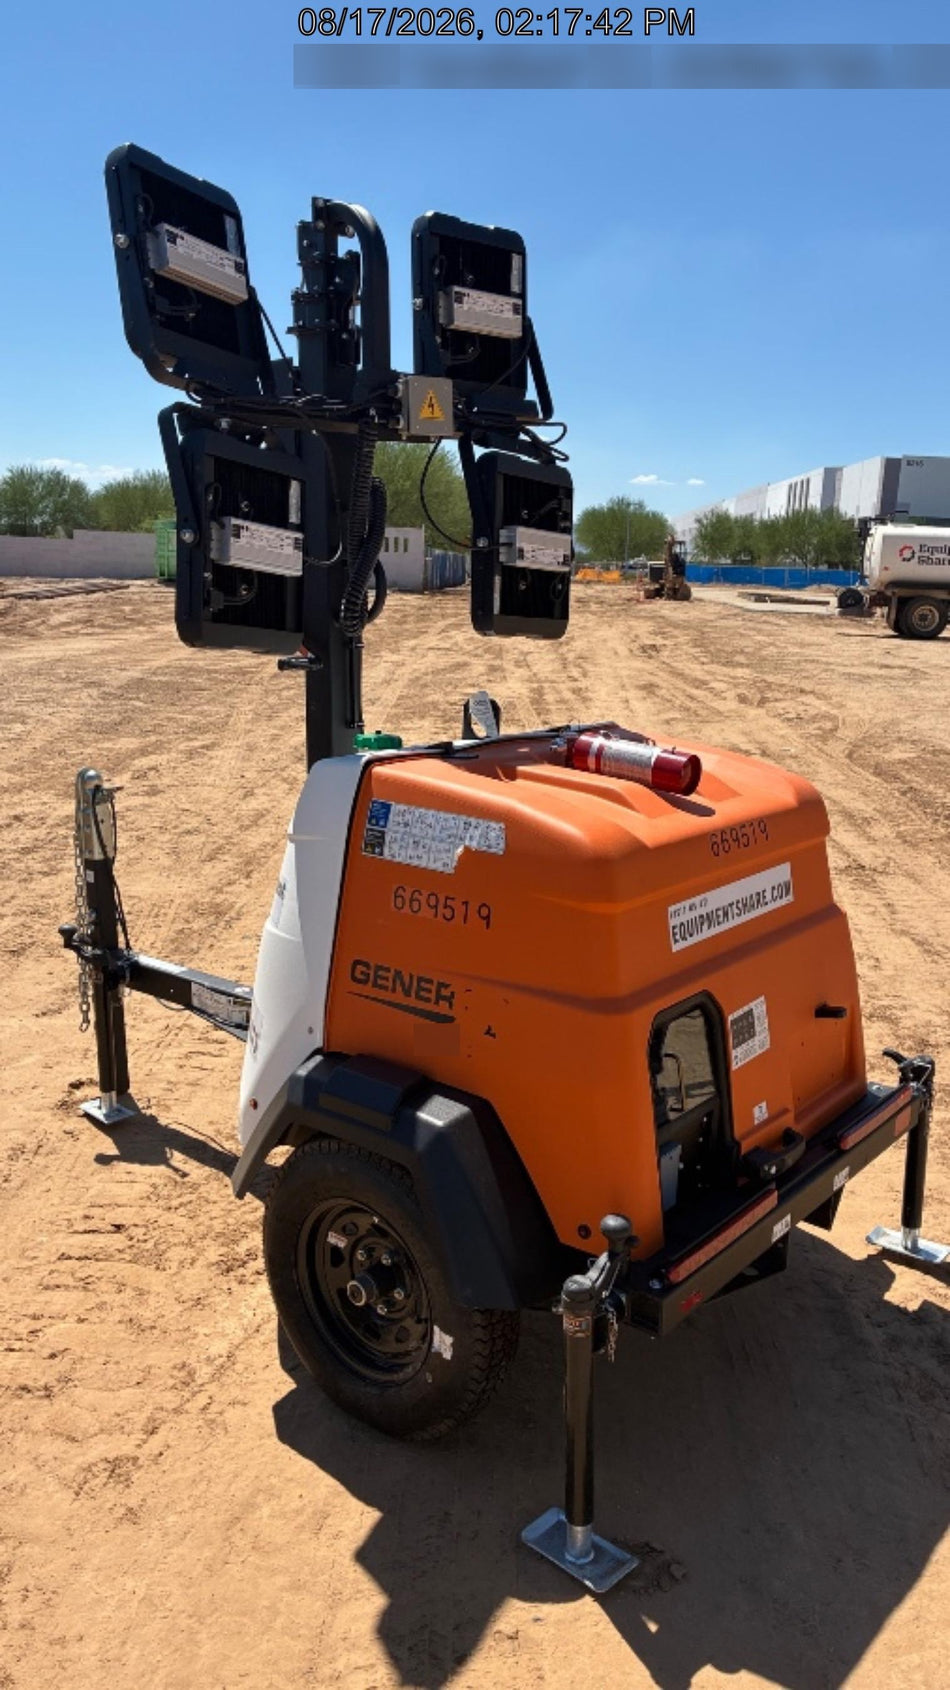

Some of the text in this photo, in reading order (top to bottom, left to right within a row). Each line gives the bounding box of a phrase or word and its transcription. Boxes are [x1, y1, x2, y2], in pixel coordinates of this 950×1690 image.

[709, 819, 769, 857] 669519
[393, 885, 491, 930] 669519
[671, 879, 791, 945] EQUIPMENTSHARE.COM
